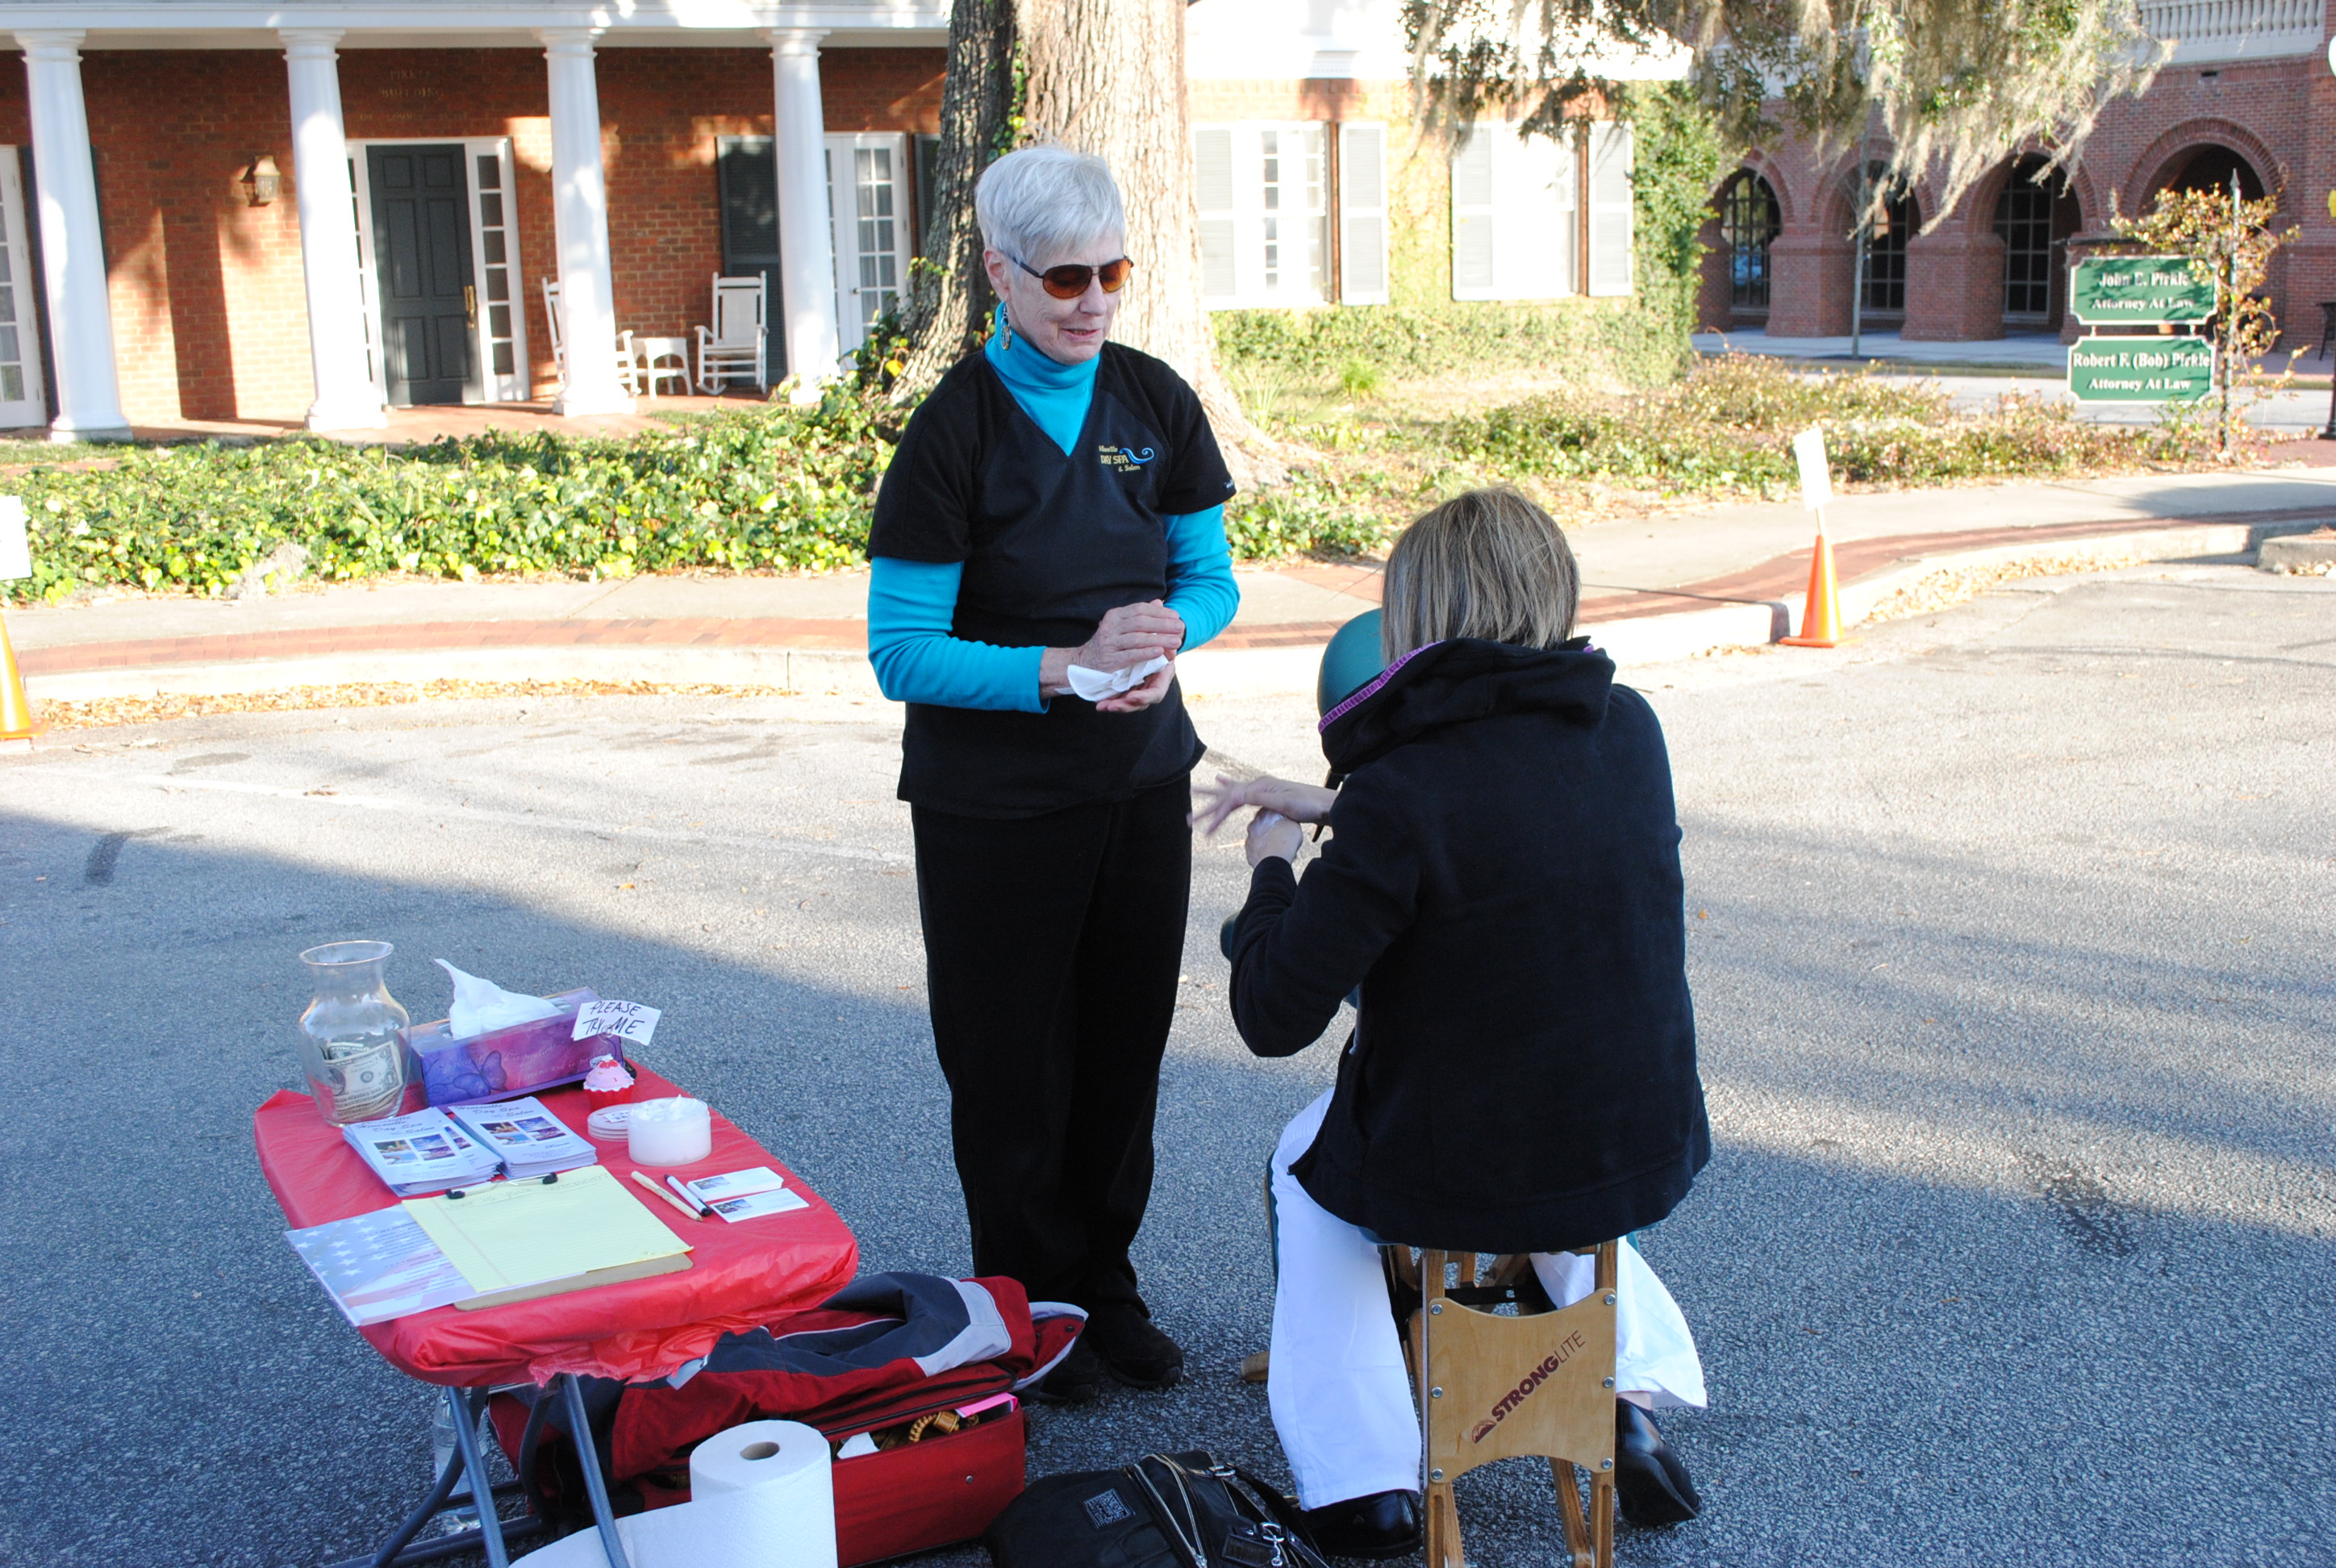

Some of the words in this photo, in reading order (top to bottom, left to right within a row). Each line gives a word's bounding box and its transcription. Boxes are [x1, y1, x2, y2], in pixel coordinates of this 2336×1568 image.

[2099, 272, 2131, 287] John
[2150, 271, 2190, 286] Pirkle
[2092, 298, 2146, 311] Attorney
[2149, 298, 2165, 310] At
[2167, 297, 2194, 309] Law
[2073, 352, 2116, 368] Robert
[2133, 352, 2169, 369] (Bob)
[2171, 352, 2211, 368] Pirkle
[2088, 377, 2143, 392] Attorney
[2145, 377, 2163, 390] At
[2164, 378, 2192, 390] Law
[1112, 454, 1129, 465] SPA
[590, 1001, 641, 1016] PLEASE
[582, 1017, 605, 1035] TRY
[611, 1016, 645, 1035] ME
[1491, 1329, 1586, 1423] STRONGLITE
